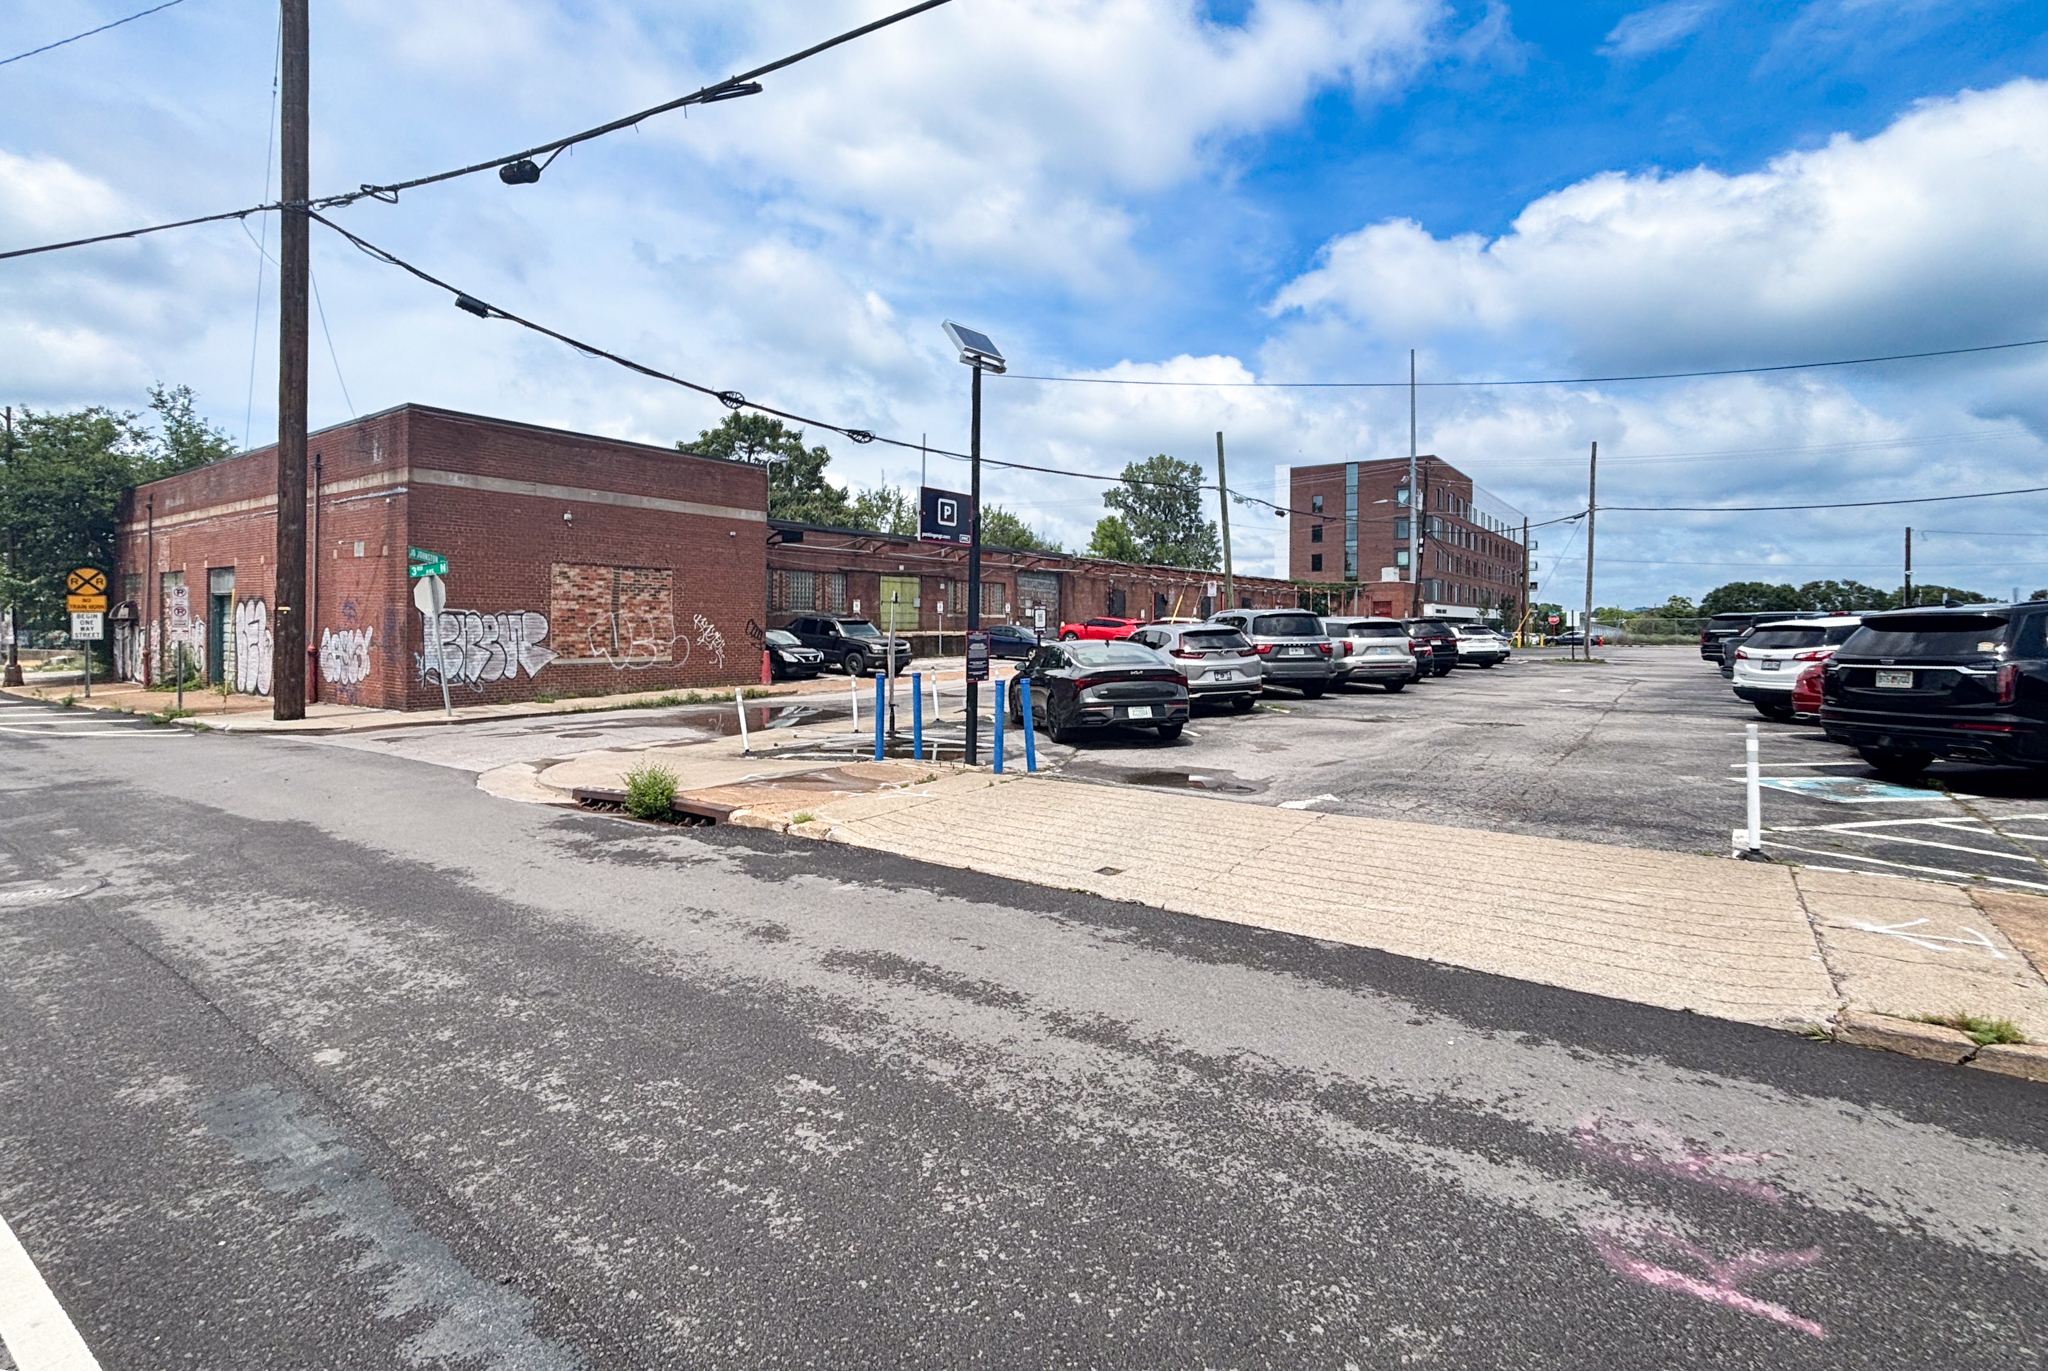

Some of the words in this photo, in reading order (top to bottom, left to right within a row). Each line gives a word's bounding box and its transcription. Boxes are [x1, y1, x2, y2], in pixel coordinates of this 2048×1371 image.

[440, 562, 446, 573] N
[70, 577, 79, 585] R
[96, 577, 104, 585] R
